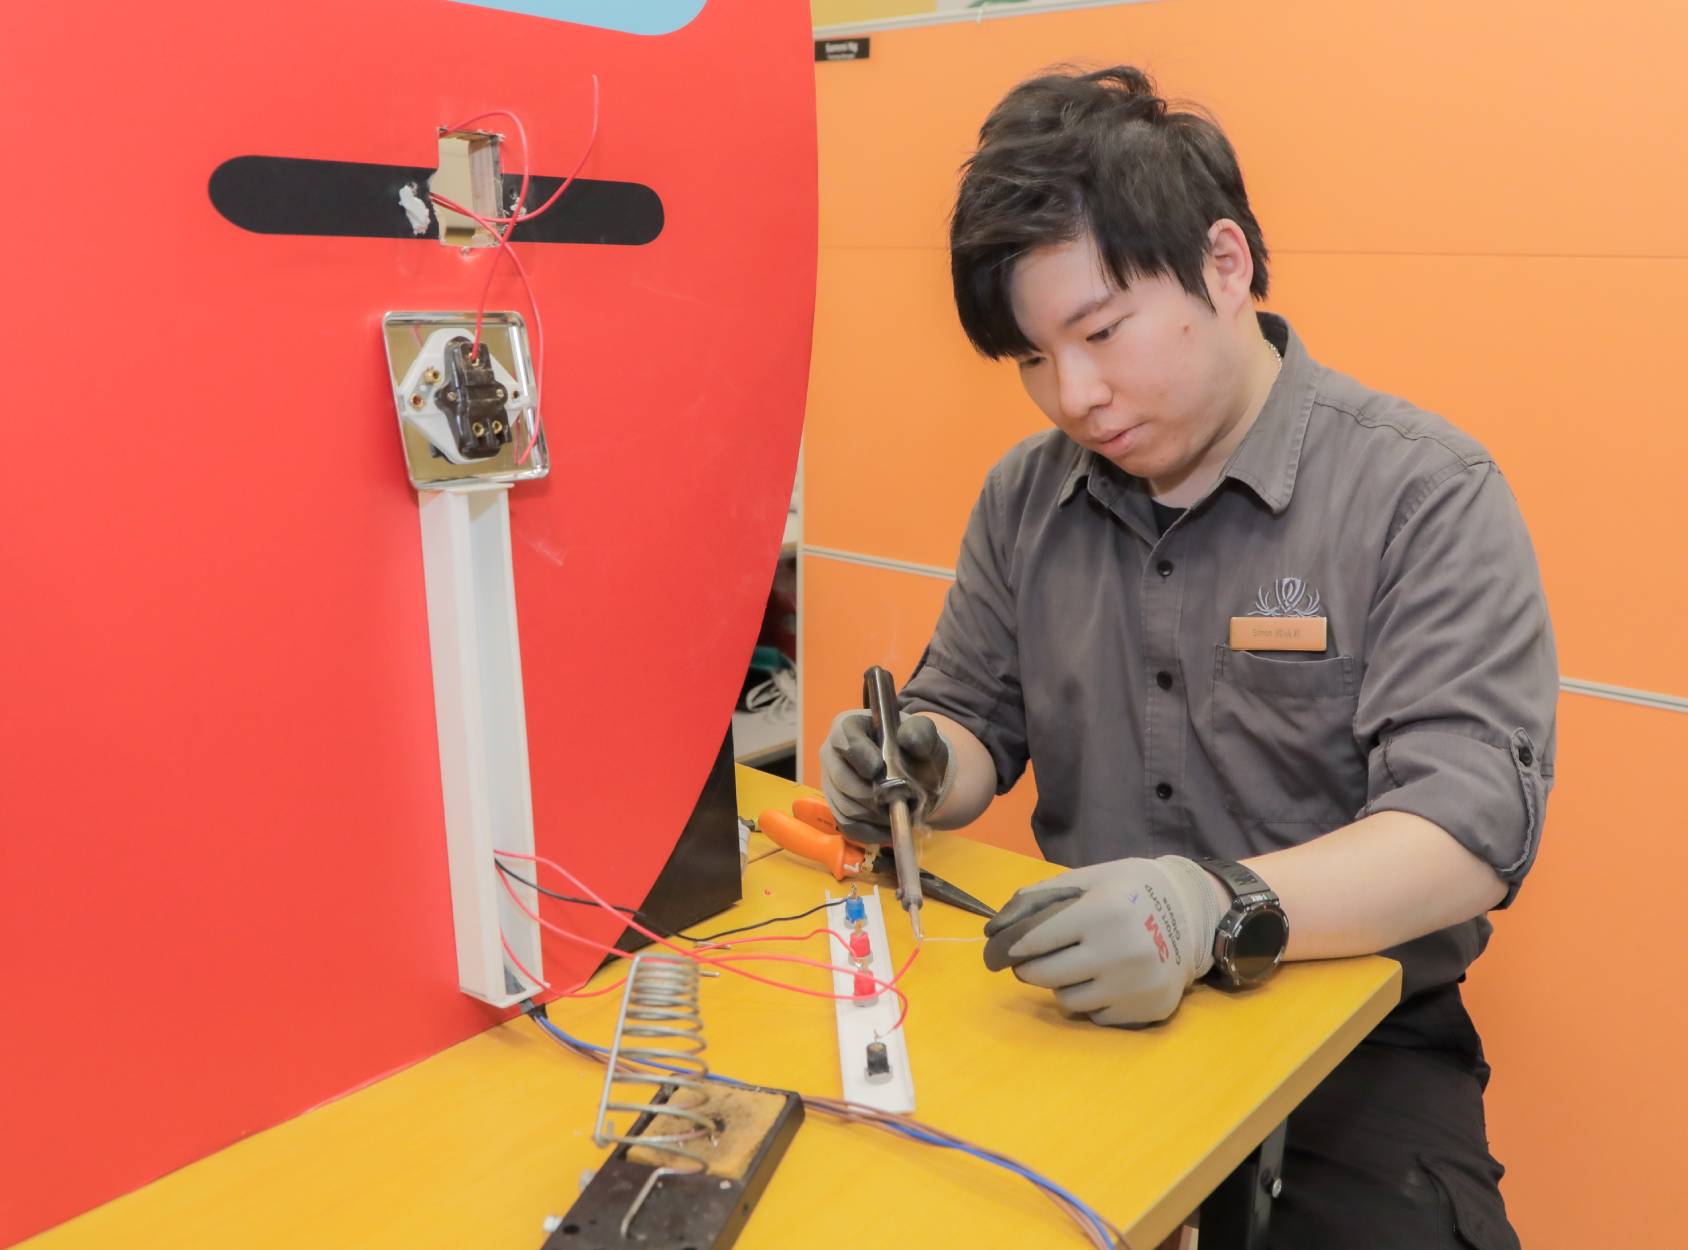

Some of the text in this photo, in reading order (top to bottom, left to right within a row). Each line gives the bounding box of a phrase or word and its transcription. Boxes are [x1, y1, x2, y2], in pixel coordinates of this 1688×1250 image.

[1144, 884, 1182, 966] Comfort Grip
[1144, 913, 1169, 963] 3M
[1163, 897, 1182, 941] Gloves
